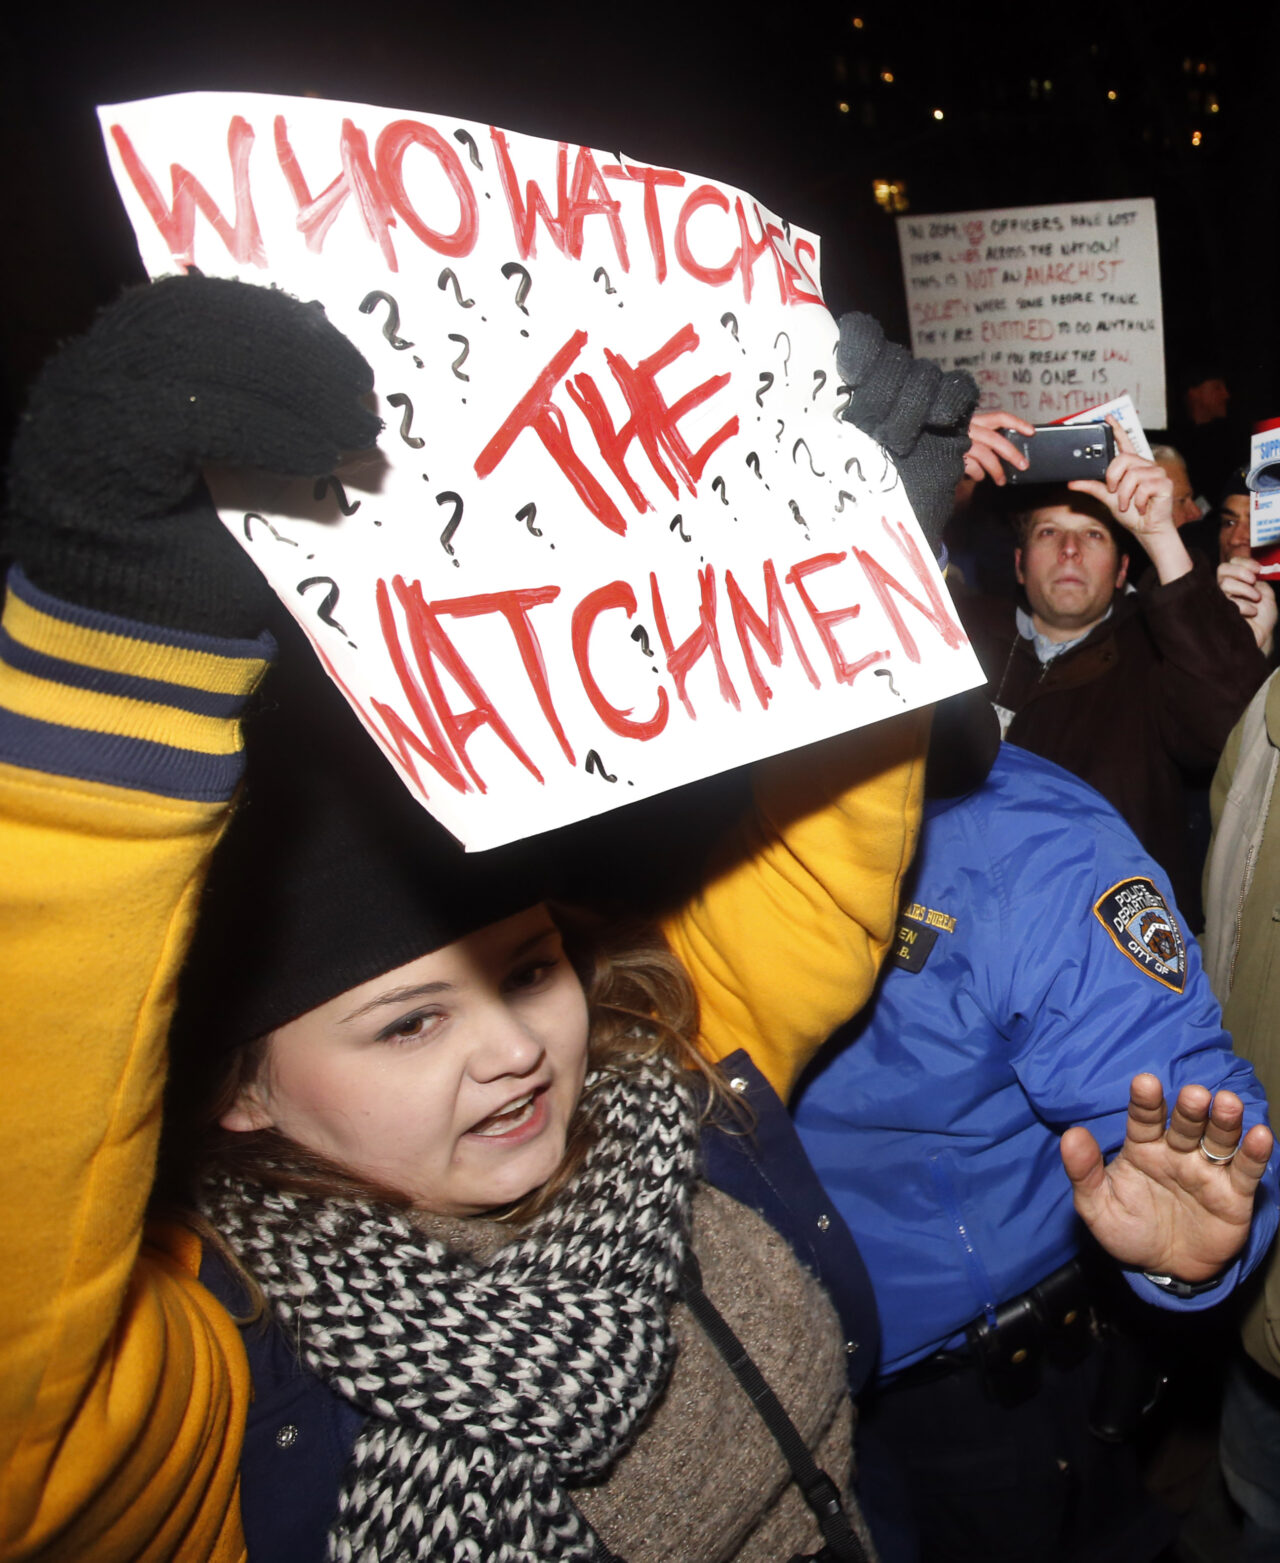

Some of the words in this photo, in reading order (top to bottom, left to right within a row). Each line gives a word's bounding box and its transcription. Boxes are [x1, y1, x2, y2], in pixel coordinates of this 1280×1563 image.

[110, 114, 479, 275] WHO
[489, 125, 827, 307] WATCHES
[990, 216, 1063, 236] OFFICERS
[1107, 210, 1137, 226] LOST
[1029, 242, 1052, 257] THE
[1061, 236, 1119, 256] NATION!
[965, 266, 998, 291] NOT
[1023, 259, 1124, 288] ANARCHIST
[1051, 292, 1093, 306] PEOPLE
[1101, 292, 1139, 305] THINK
[981, 318, 1053, 344] ENTITLED
[1029, 349, 1069, 364] BREAK
[1072, 349, 1097, 363] THE
[1012, 368, 1032, 385] NO
[1040, 369, 1083, 386] ONE
[1091, 367, 1108, 384] IS
[1009, 390, 1029, 410] TO
[473, 323, 740, 536] THE
[325, 516, 967, 800] WATCHMEN
[1127, 940, 1153, 964] CITY
[1154, 962, 1170, 976] OF
